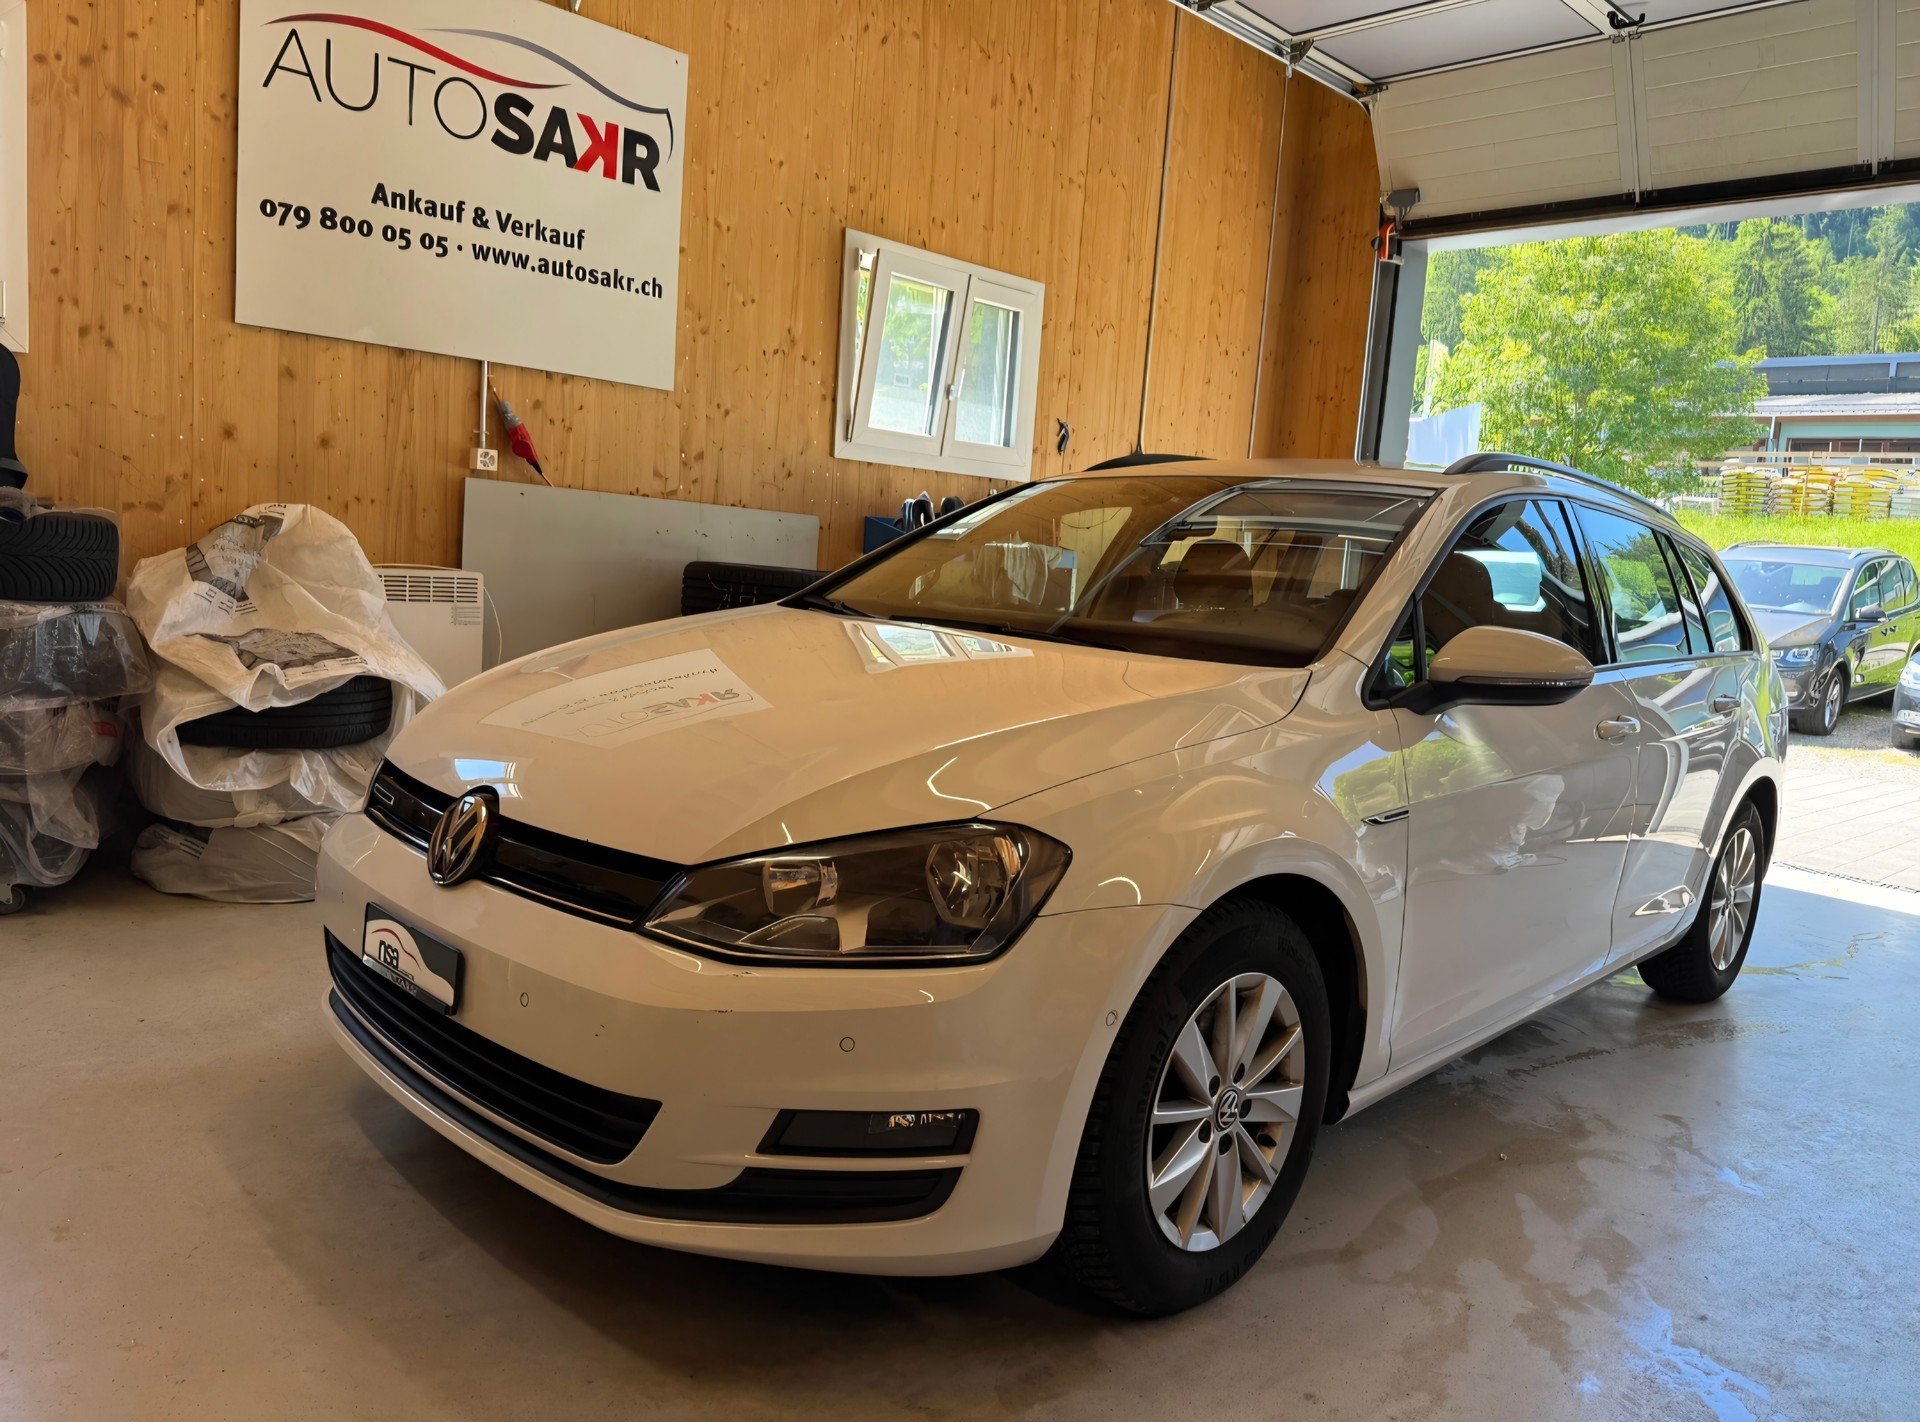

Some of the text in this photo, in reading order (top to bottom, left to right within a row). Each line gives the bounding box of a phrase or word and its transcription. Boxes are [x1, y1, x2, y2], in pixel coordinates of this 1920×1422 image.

[262, 28, 661, 192] AUTOSAKR
[259, 198, 663, 299] 079 800 05 05 www.autosakr.ch
[371, 182, 587, 251] Ankauf & Verkauf
